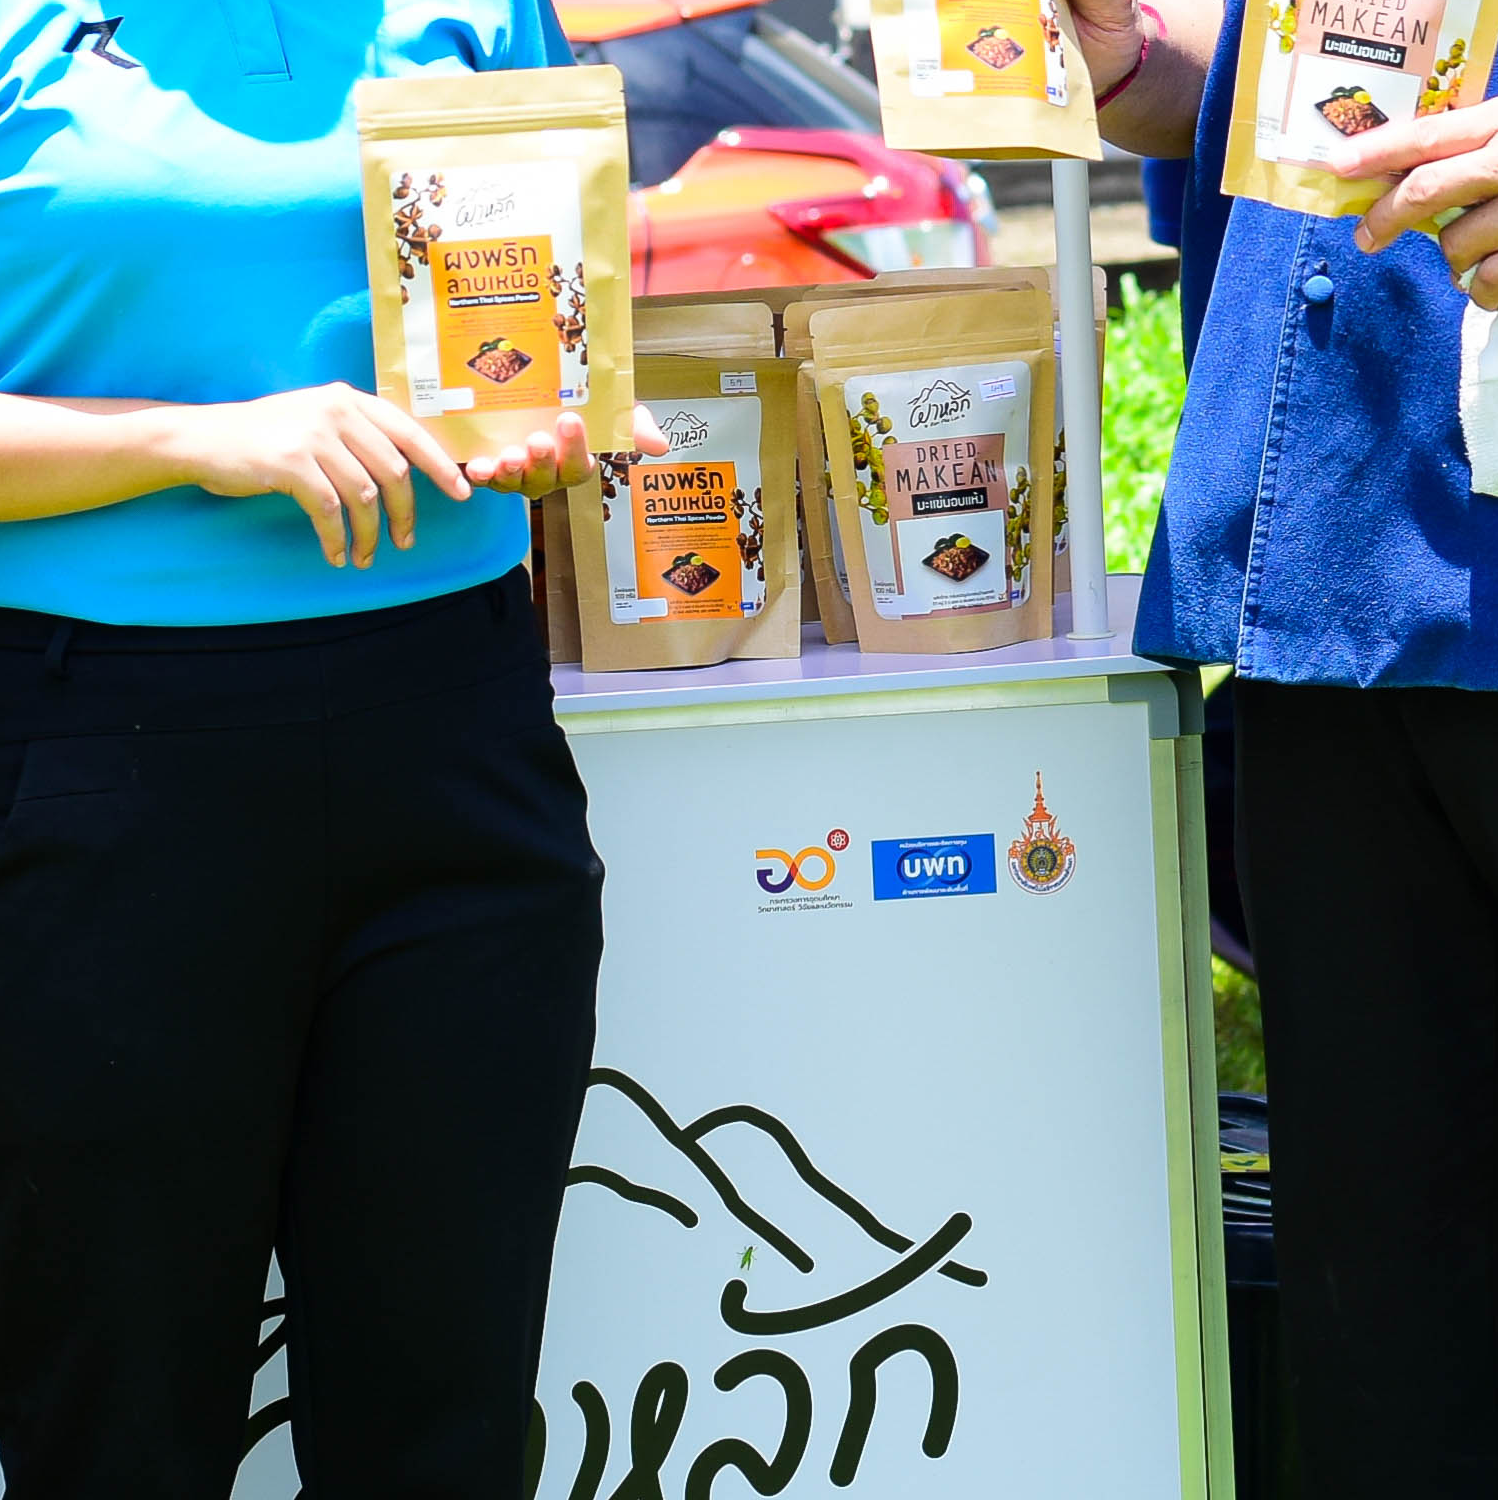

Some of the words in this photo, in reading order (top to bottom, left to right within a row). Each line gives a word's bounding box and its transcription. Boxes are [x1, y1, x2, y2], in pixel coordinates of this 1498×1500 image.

[1310, 0, 1429, 46] MAKEAN
[444, 242, 537, 271] ผงพริก
[446, 268, 539, 294] ลาบเหนือ
[916, 441, 977, 464] DRIED
[643, 466, 724, 492] ผงพริก
[896, 459, 998, 493] MAKEAN
[645, 489, 726, 513] ลาบเหนือ
